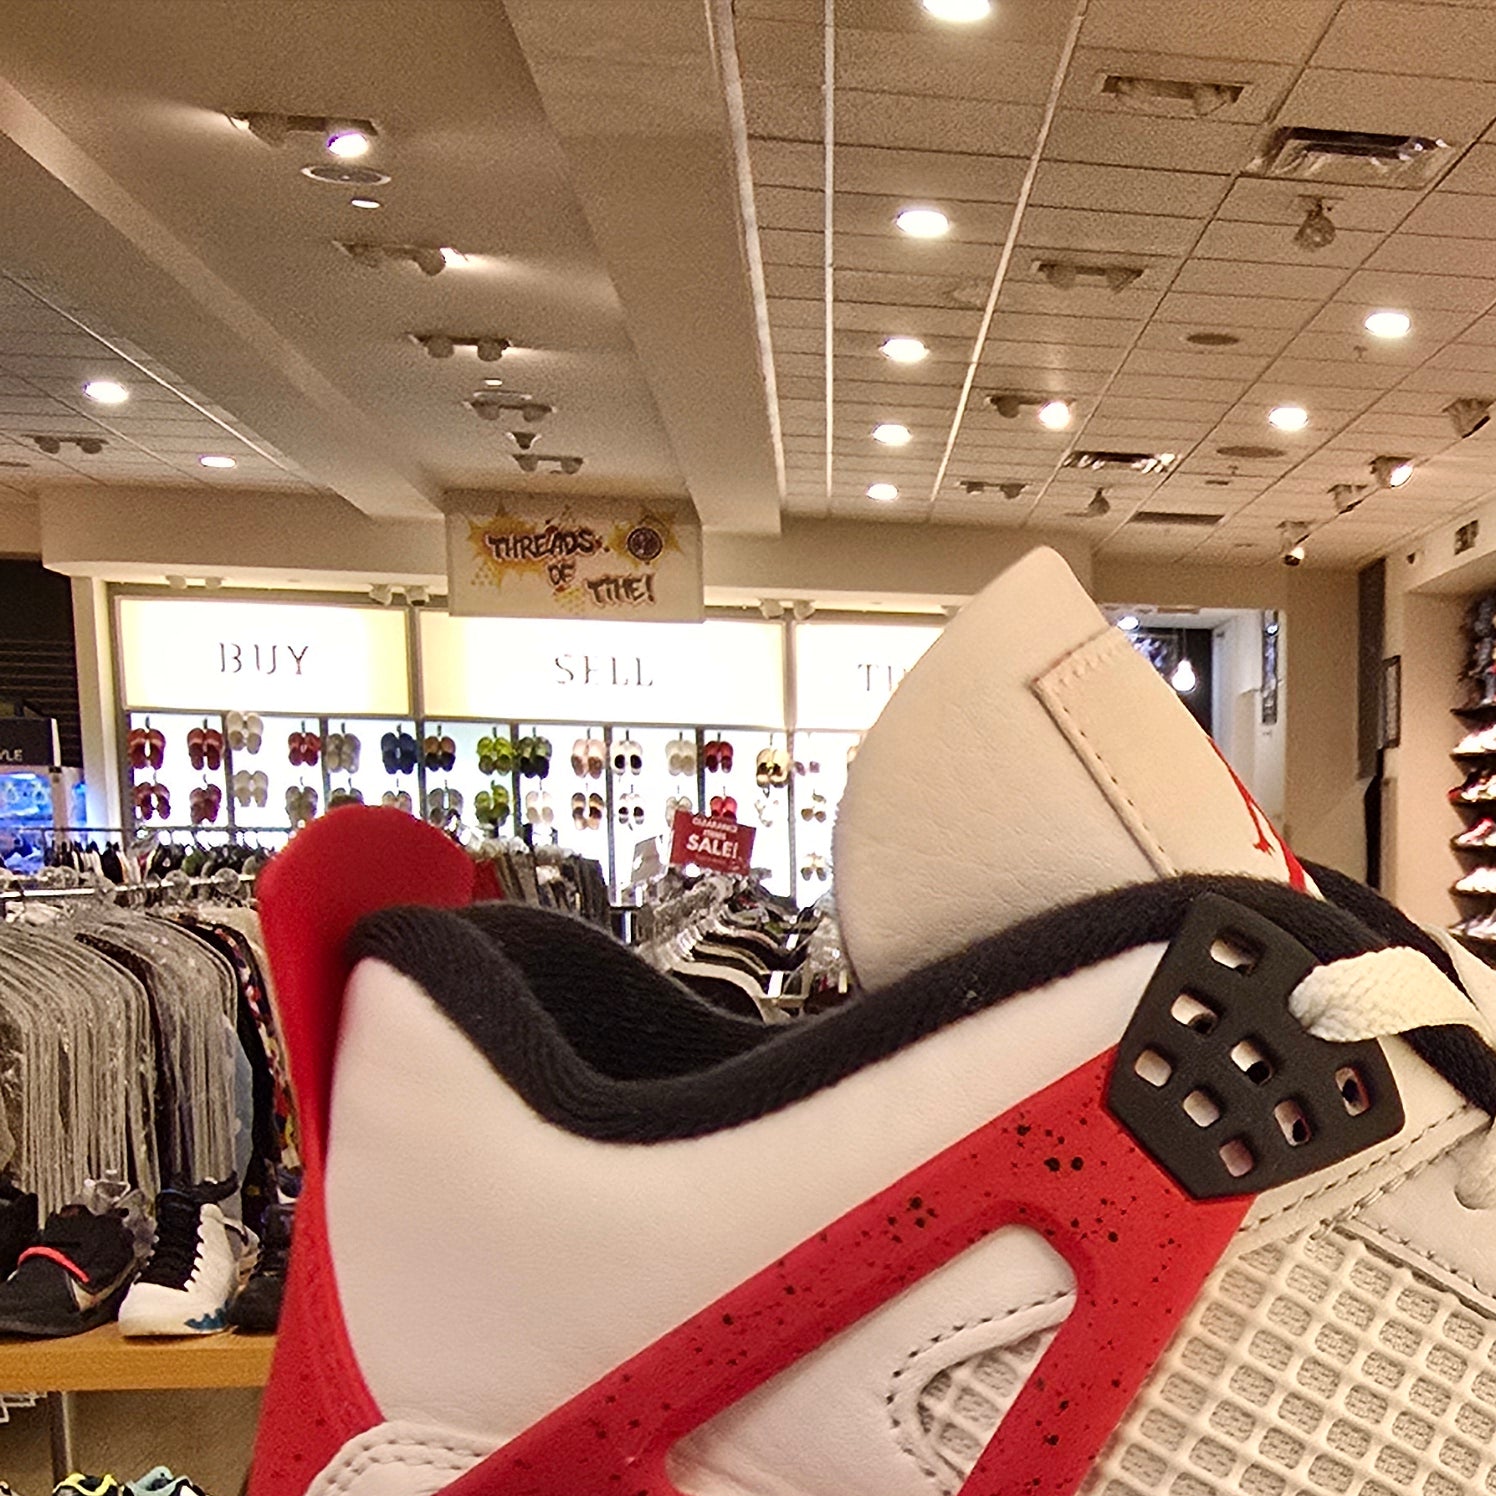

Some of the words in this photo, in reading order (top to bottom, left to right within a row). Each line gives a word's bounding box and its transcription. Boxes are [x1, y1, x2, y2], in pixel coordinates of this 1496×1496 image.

[487, 527, 595, 560] THREADS
[219, 642, 309, 675] BUY
[554, 653, 653, 687] SELL
[685, 833, 739, 865] SALE!
